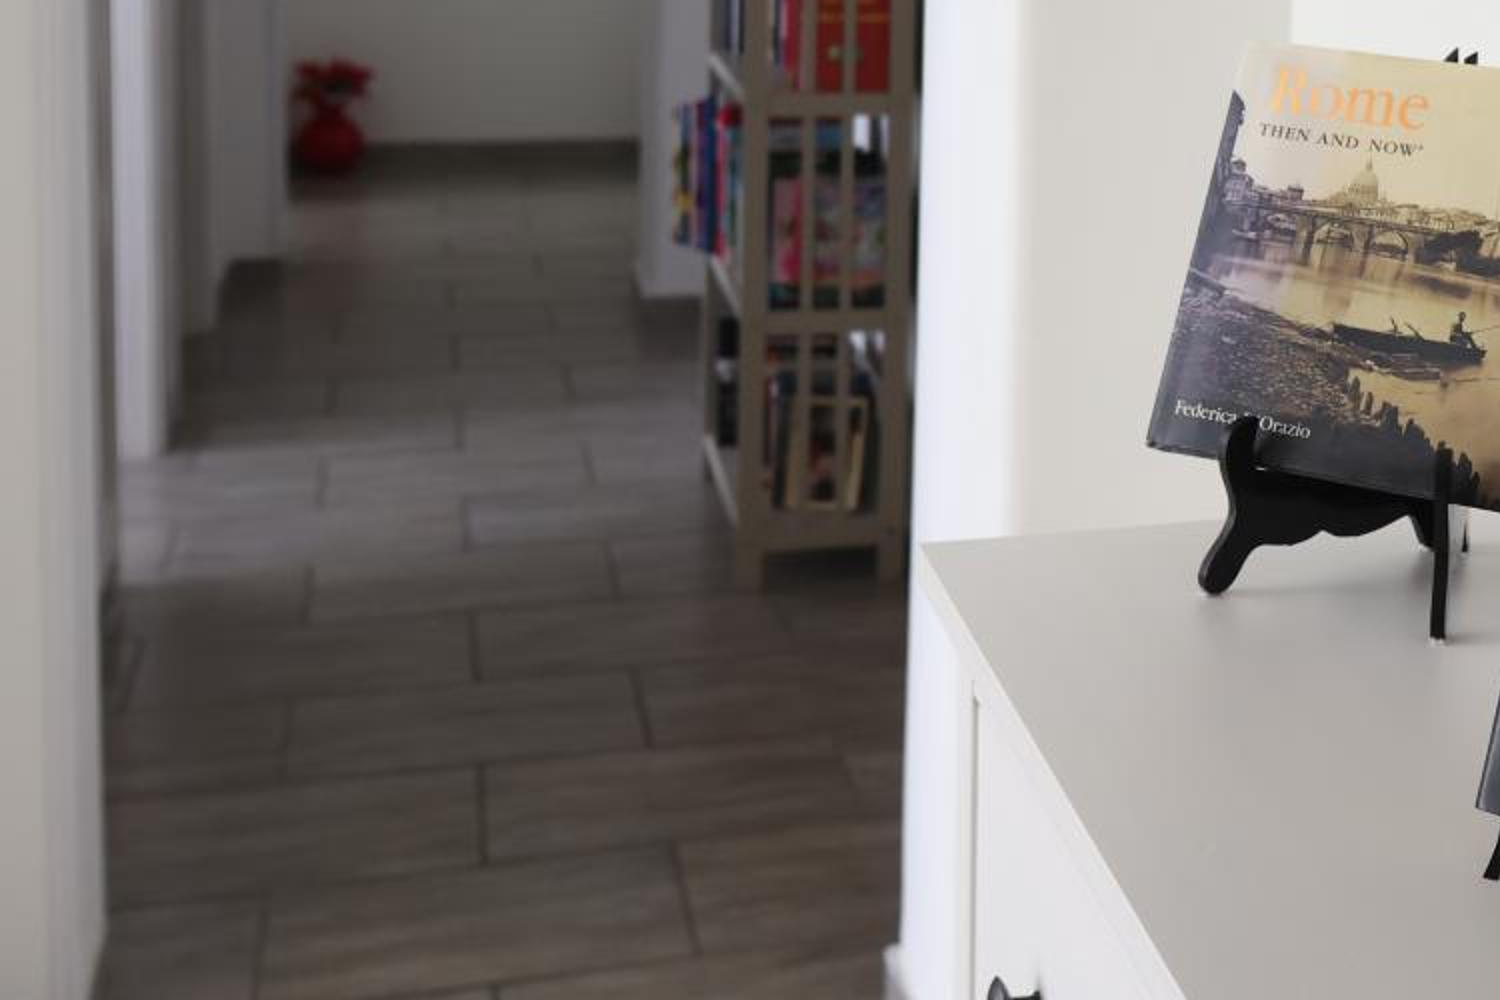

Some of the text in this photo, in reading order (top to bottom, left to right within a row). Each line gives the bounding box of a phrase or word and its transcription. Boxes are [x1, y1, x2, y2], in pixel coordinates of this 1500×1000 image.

[1272, 65, 1430, 130] Rome
[1260, 122, 1311, 142] THEN
[1316, 132, 1359, 149] AND
[1175, 399, 1238, 425] Federica
